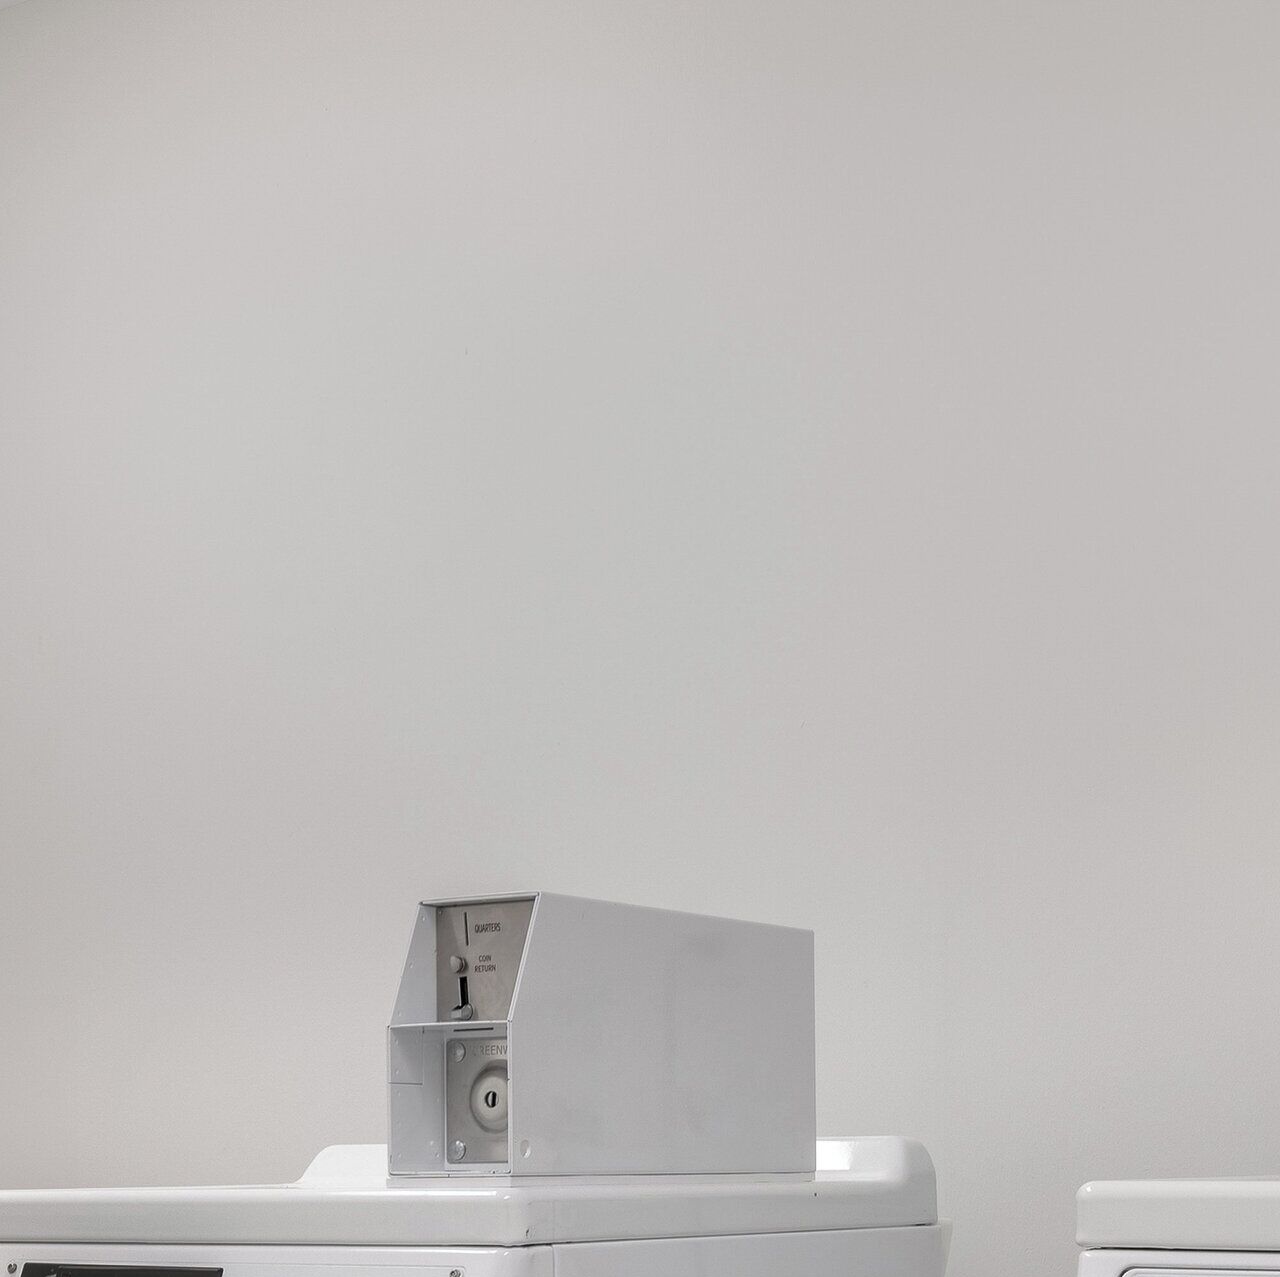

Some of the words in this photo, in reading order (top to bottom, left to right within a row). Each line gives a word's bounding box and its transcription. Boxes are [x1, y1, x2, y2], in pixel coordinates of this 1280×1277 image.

[474, 922, 501, 934] QUARTERS
[478, 954, 492, 962] COIN
[474, 964, 497, 973] RETURN
